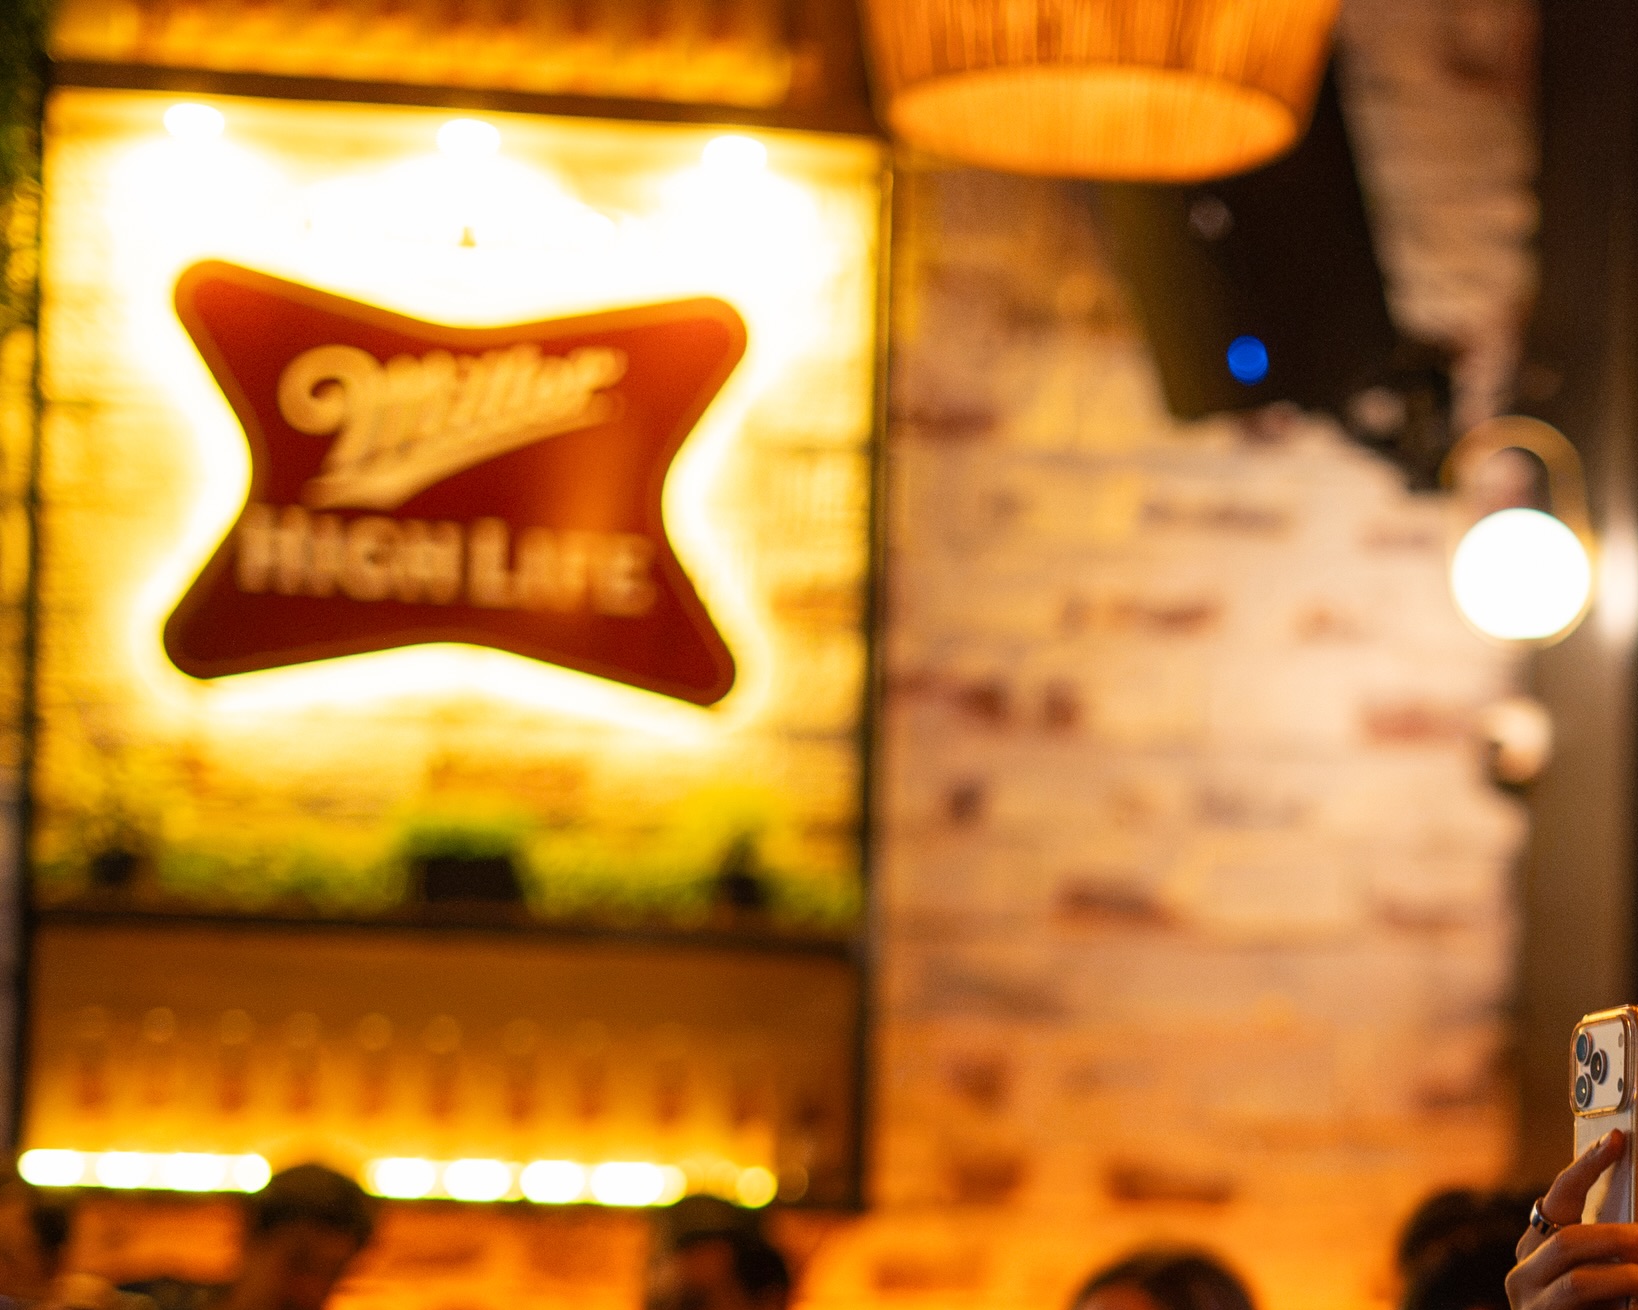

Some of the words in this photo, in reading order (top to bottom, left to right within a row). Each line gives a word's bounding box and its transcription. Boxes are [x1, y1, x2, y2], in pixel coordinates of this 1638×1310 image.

[280, 345, 625, 508] Miller
[238, 508, 463, 602] HIGH
[468, 517, 653, 614] LIFE
